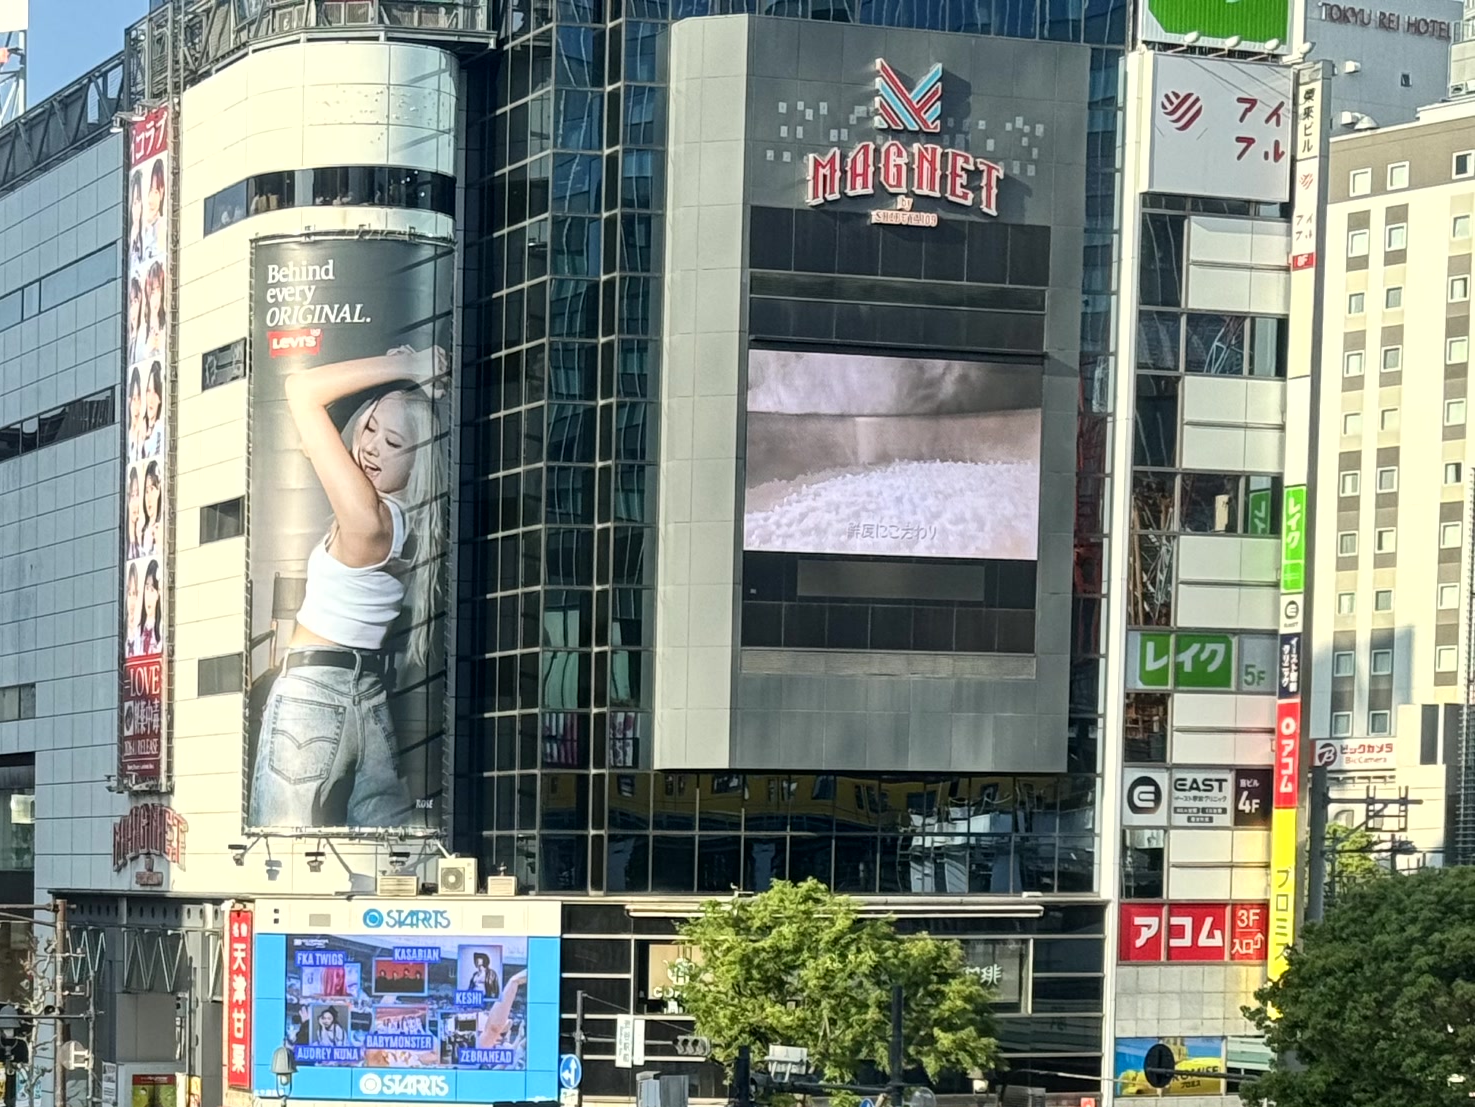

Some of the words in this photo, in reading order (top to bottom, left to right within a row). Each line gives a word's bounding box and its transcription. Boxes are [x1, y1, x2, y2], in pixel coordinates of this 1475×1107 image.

[1321, 2, 1372, 27] TOKYU
[1379, 11, 1400, 30] REI
[1406, 16, 1452, 41] HOTEL
[1235, 96, 1285, 128] アイ
[1235, 136, 1286, 163] フル
[805, 140, 1004, 217] MAGNET
[267, 259, 335, 285] Behind
[266, 283, 316, 305] every
[266, 303, 373, 328] ORIGINAL.
[1286, 496, 1302, 548] レイク
[1144, 641, 1224, 673] レイク
[1243, 663, 1266, 687] 5F
[1339, 742, 1394, 755] ビックカメラ
[1279, 738, 1296, 793] アコム
[1173, 777, 1228, 793] EAST
[1237, 790, 1261, 814] 4F
[385, 909, 451, 929] STARTS
[1237, 909, 1261, 928] 3F
[1132, 915, 1224, 949] アコム
[394, 948, 440, 962] KASABIAN
[1231, 938, 1254, 955] 入口
[297, 953, 315, 965] FKA
[316, 954, 344, 966] TWIGS
[231, 943, 248, 1074] 天津甘栗
[455, 992, 482, 1005] KESHI
[297, 1047, 332, 1061] AUDREY
[334, 1047, 359, 1061] NUNA
[366, 1036, 432, 1050] BABYMONSTER
[460, 1049, 512, 1064] ZEBRAHEAD
[382, 1073, 450, 1097] STARTS
